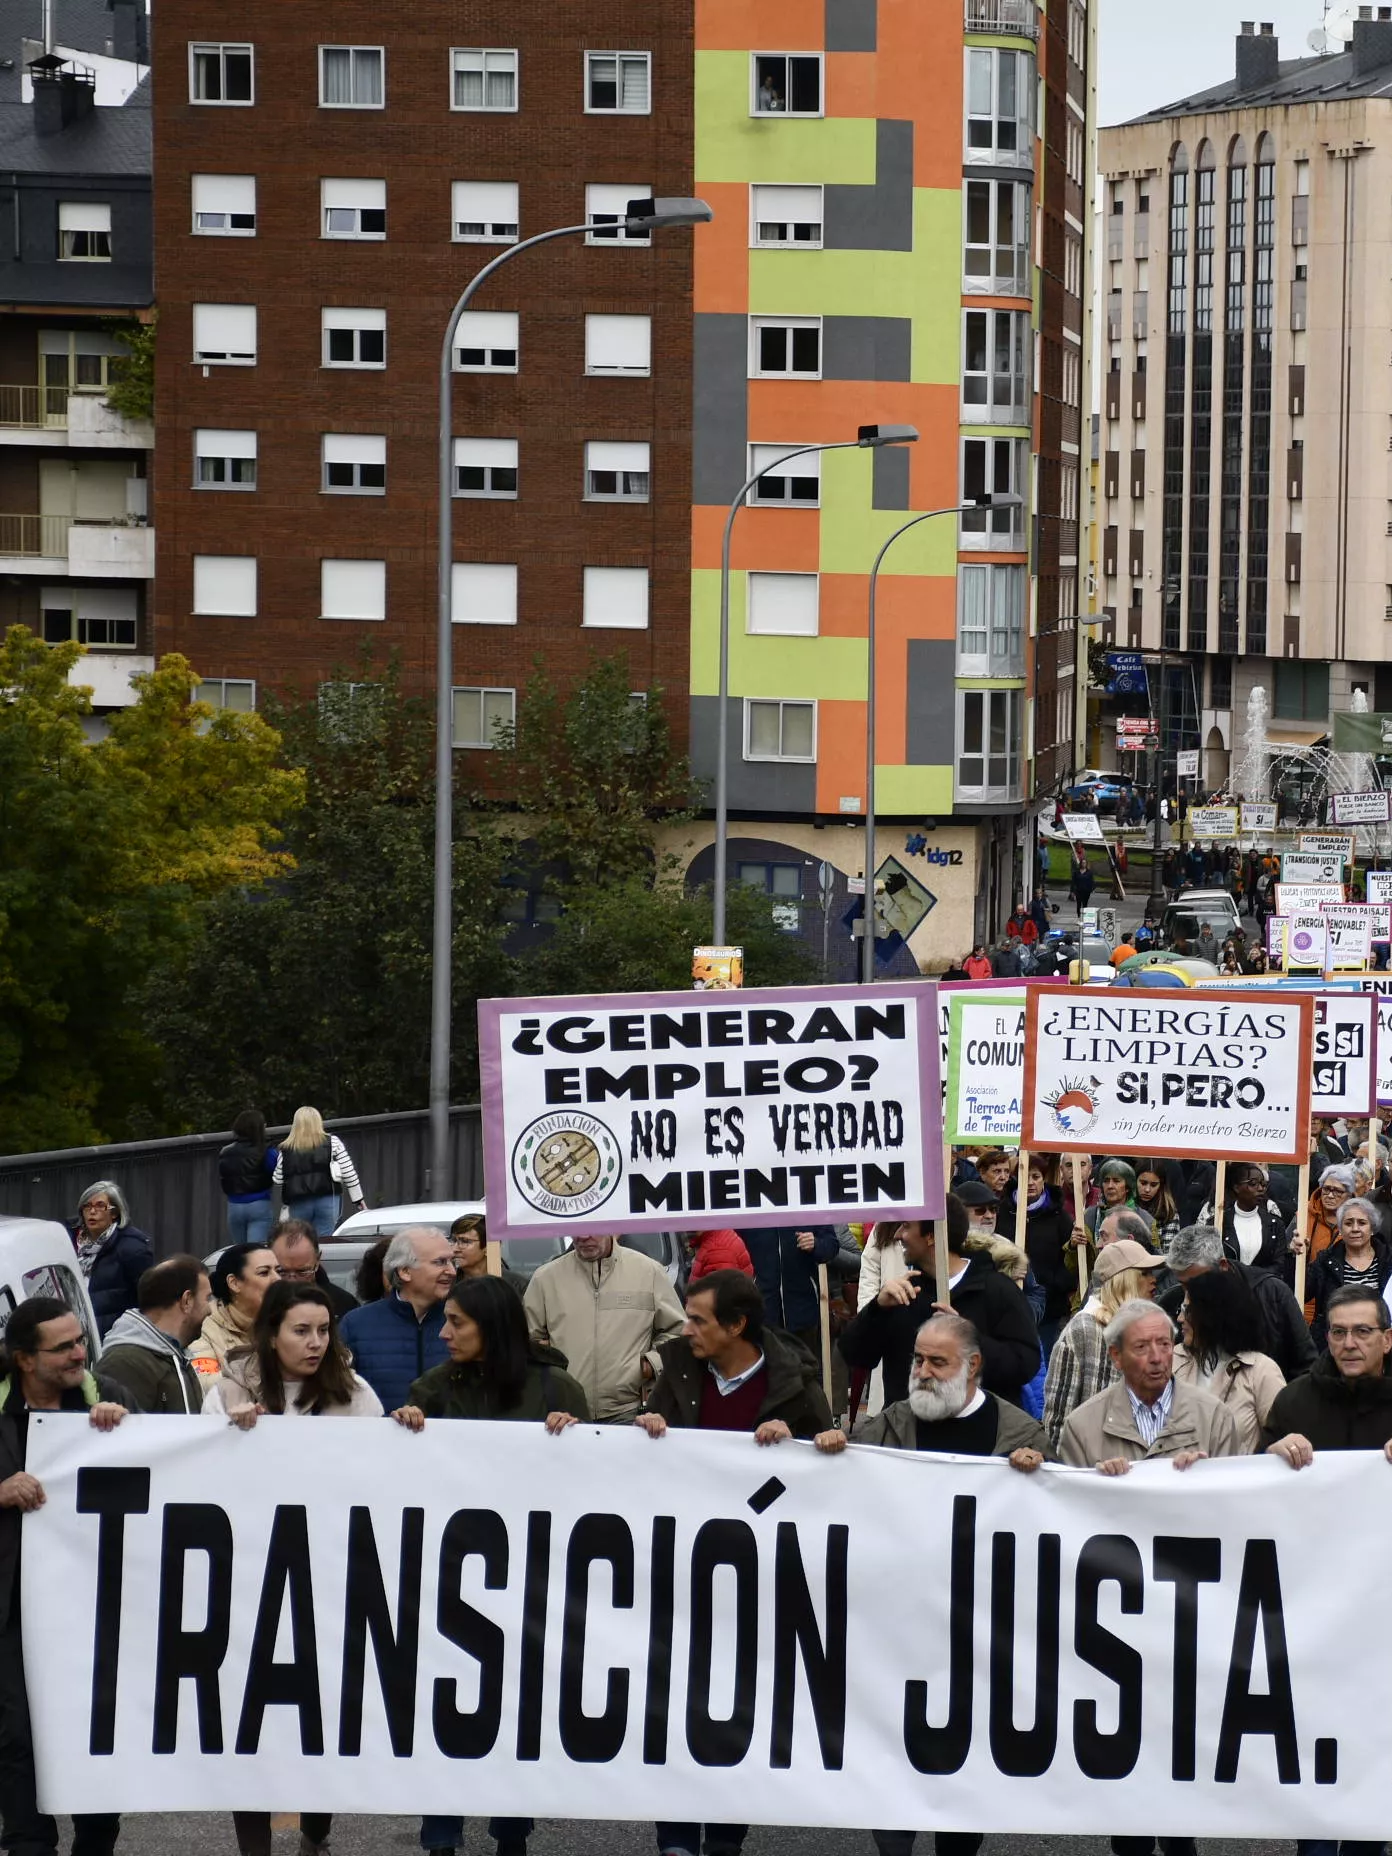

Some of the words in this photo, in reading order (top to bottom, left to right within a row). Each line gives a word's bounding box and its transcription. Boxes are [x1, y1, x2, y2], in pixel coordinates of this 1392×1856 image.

[1354, 794, 1386, 802] BIERZO
[1302, 835, 1350, 844] ¿GENERARÁN
[927, 847, 963, 866] idg12
[1378, 882, 1390, 890] NO
[1294, 916, 1325, 929] ¿ENERGÍA
[1329, 918, 1366, 931] ENOVABLE?
[1359, 906, 1390, 916] PAISAJE
[511, 1003, 906, 1056] ¿GENERAN
[995, 1017, 1007, 1035] EL
[1043, 1004, 1287, 1040] ¿ENERGÍAS
[1062, 1036, 1268, 1070] LIMPIAS?
[1336, 1024, 1361, 1057] SÍ
[544, 1053, 880, 1106] EMPLEO?
[1115, 1071, 1156, 1110] SI,
[1161, 1072, 1290, 1112] PERO...
[1312, 1063, 1341, 1095] SÍ
[965, 1096, 1006, 1115] Tierras
[530, 1114, 602, 1140] FUNDACIÓN
[630, 1107, 677, 1164] NO
[704, 1104, 744, 1164] ES
[768, 1099, 905, 1157] VERDAD
[964, 1115, 978, 1133] de
[981, 1114, 1021, 1134] Trevinc
[1111, 1117, 1133, 1132] sin
[1127, 1114, 1175, 1140] joder
[1178, 1120, 1233, 1138] nuestro
[1237, 1121, 1288, 1140] Bierzo
[533, 1188, 569, 1213] PRADA
[571, 1187, 603, 1212] TOPE
[627, 1161, 906, 1215] MIENTEN
[76, 1475, 850, 1772] TRANSICIÓN
[903, 1495, 1339, 1786] JUSTA.
